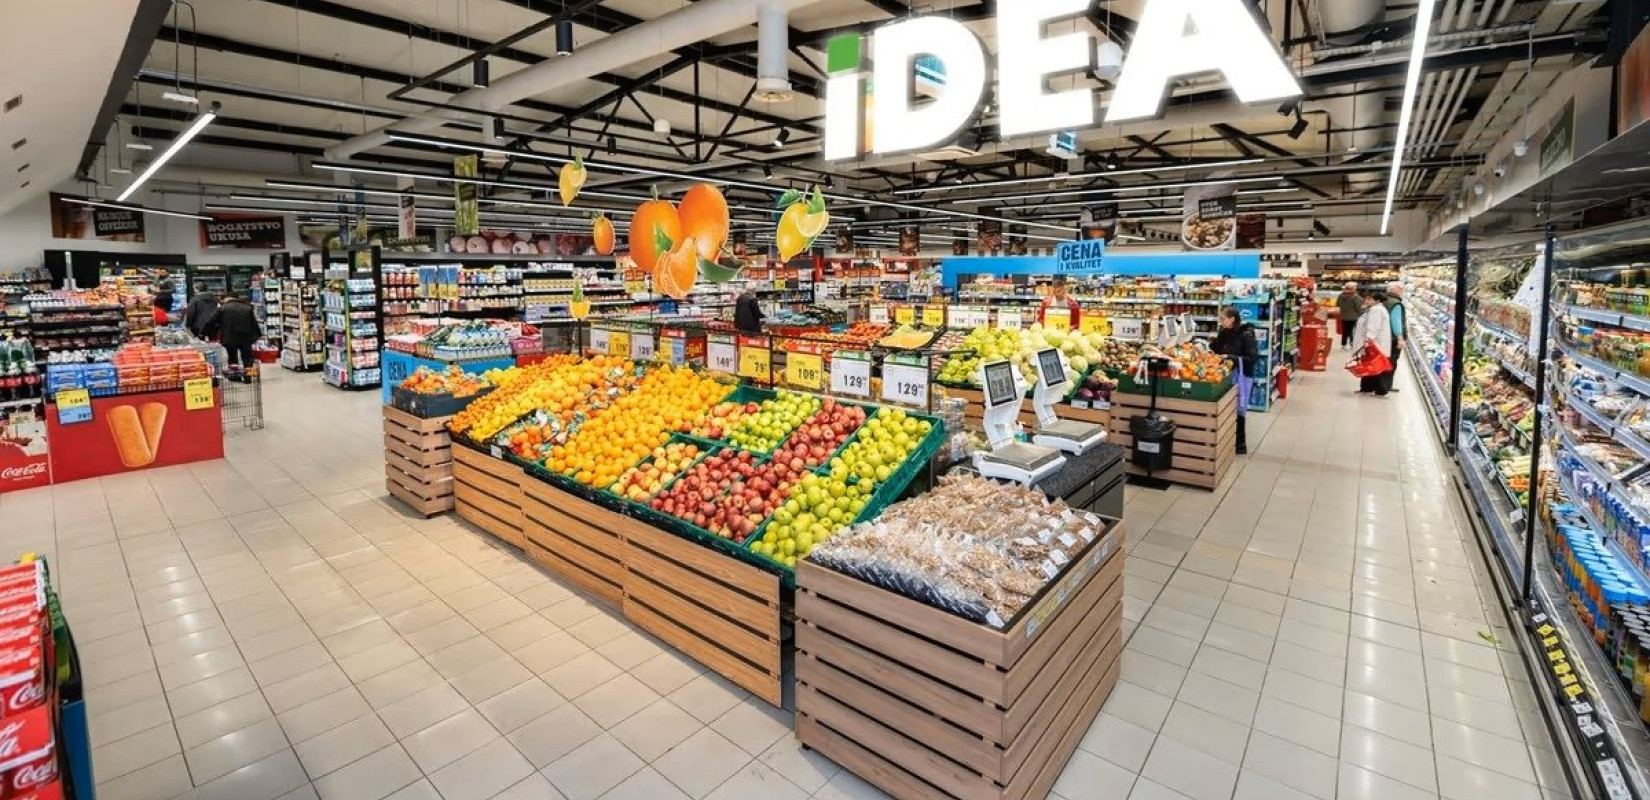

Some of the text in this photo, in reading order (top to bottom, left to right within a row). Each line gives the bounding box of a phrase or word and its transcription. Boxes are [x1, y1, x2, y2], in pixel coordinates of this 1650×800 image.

[210, 232, 252, 242] UKUSA
[1061, 242, 1102, 261] CENA
[1060, 259, 1102, 270] I KVALITET
[389, 361, 408, 381] CENA
[798, 368, 815, 380] 109
[843, 374, 863, 388] 129
[897, 382, 917, 396] 129
